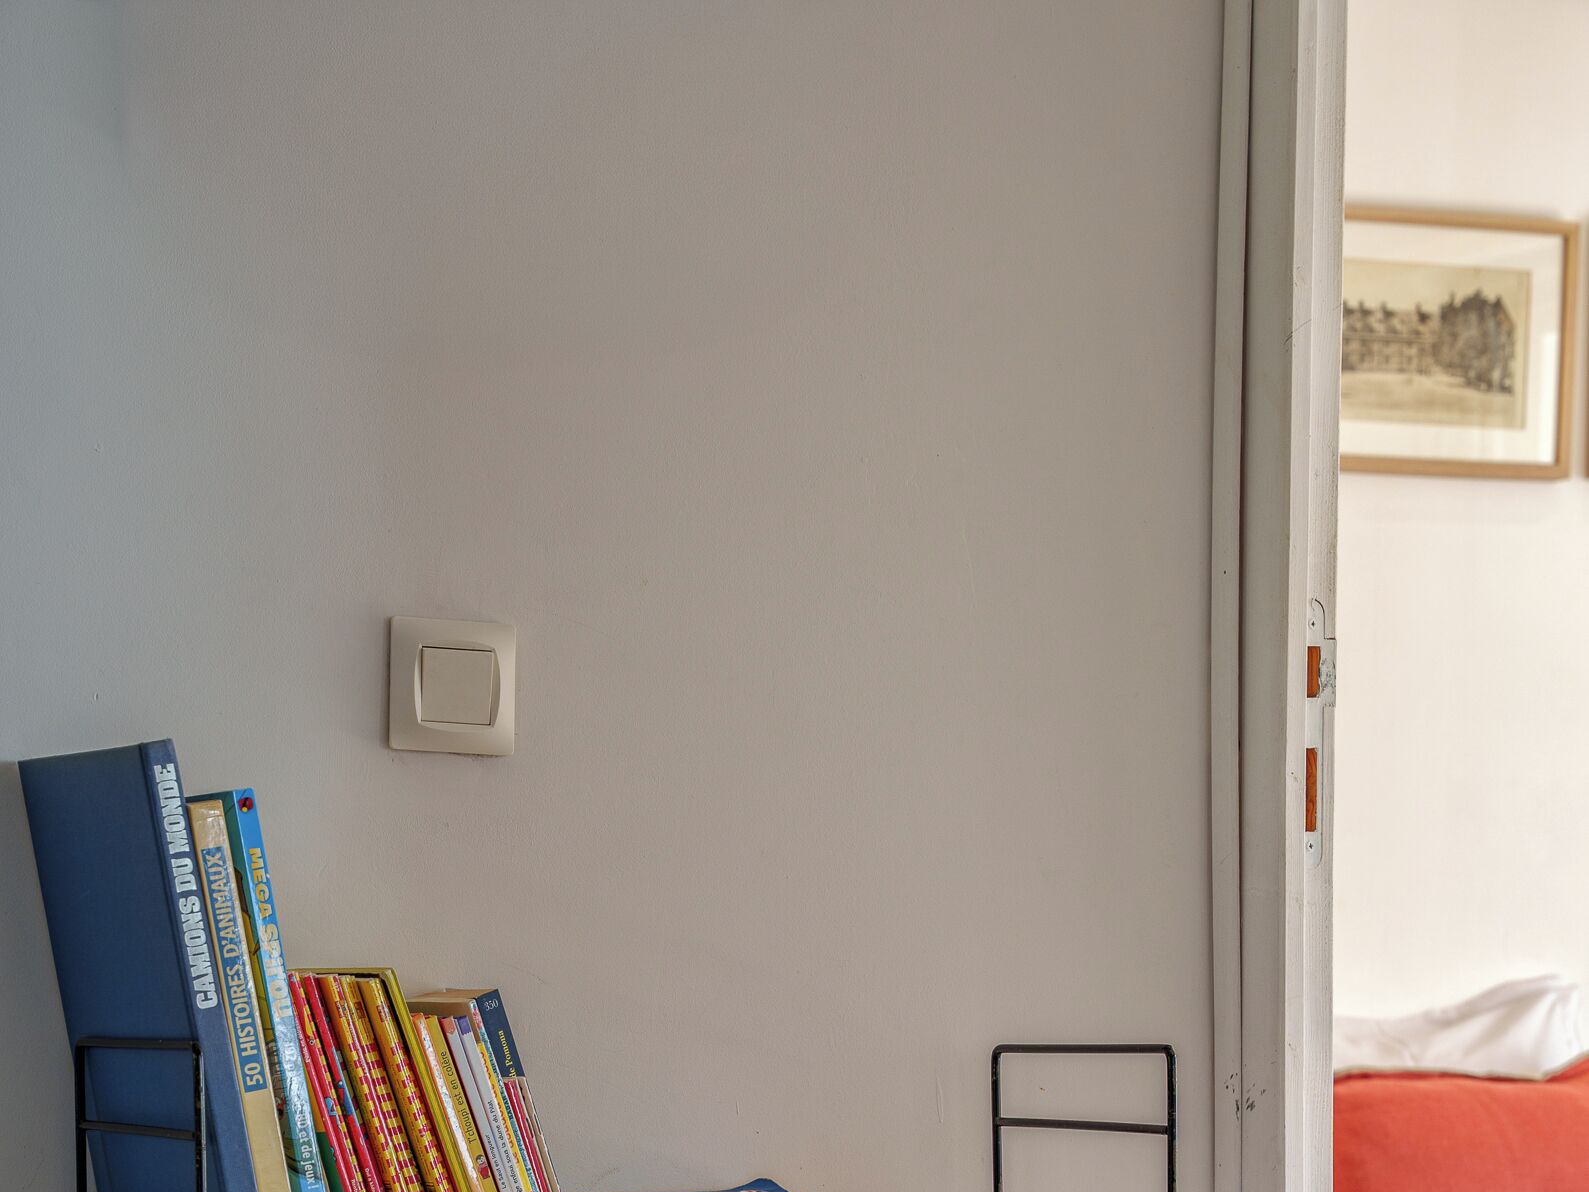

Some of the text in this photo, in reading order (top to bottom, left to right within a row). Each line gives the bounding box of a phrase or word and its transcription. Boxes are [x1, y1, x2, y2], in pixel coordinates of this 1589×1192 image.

[154, 763, 218, 1009] CAMIONS DU MONDE
[206, 851, 264, 1087] 50 HISTOIRES D'ANIMAUX
[484, 999, 498, 1010] 350
[494, 1029, 514, 1065] Pomona
[437, 1050, 479, 1145] T'choupi est en colère
[298, 1130, 310, 1142] et
[493, 1124, 504, 1141] dune
[300, 1143, 313, 1158] de
[482, 1132, 498, 1159] longueur
[502, 1149, 512, 1163] sous
[494, 1167, 504, 1181] Saut
[506, 1163, 518, 1184] enfoui
[499, 1180, 507, 1189] Le
